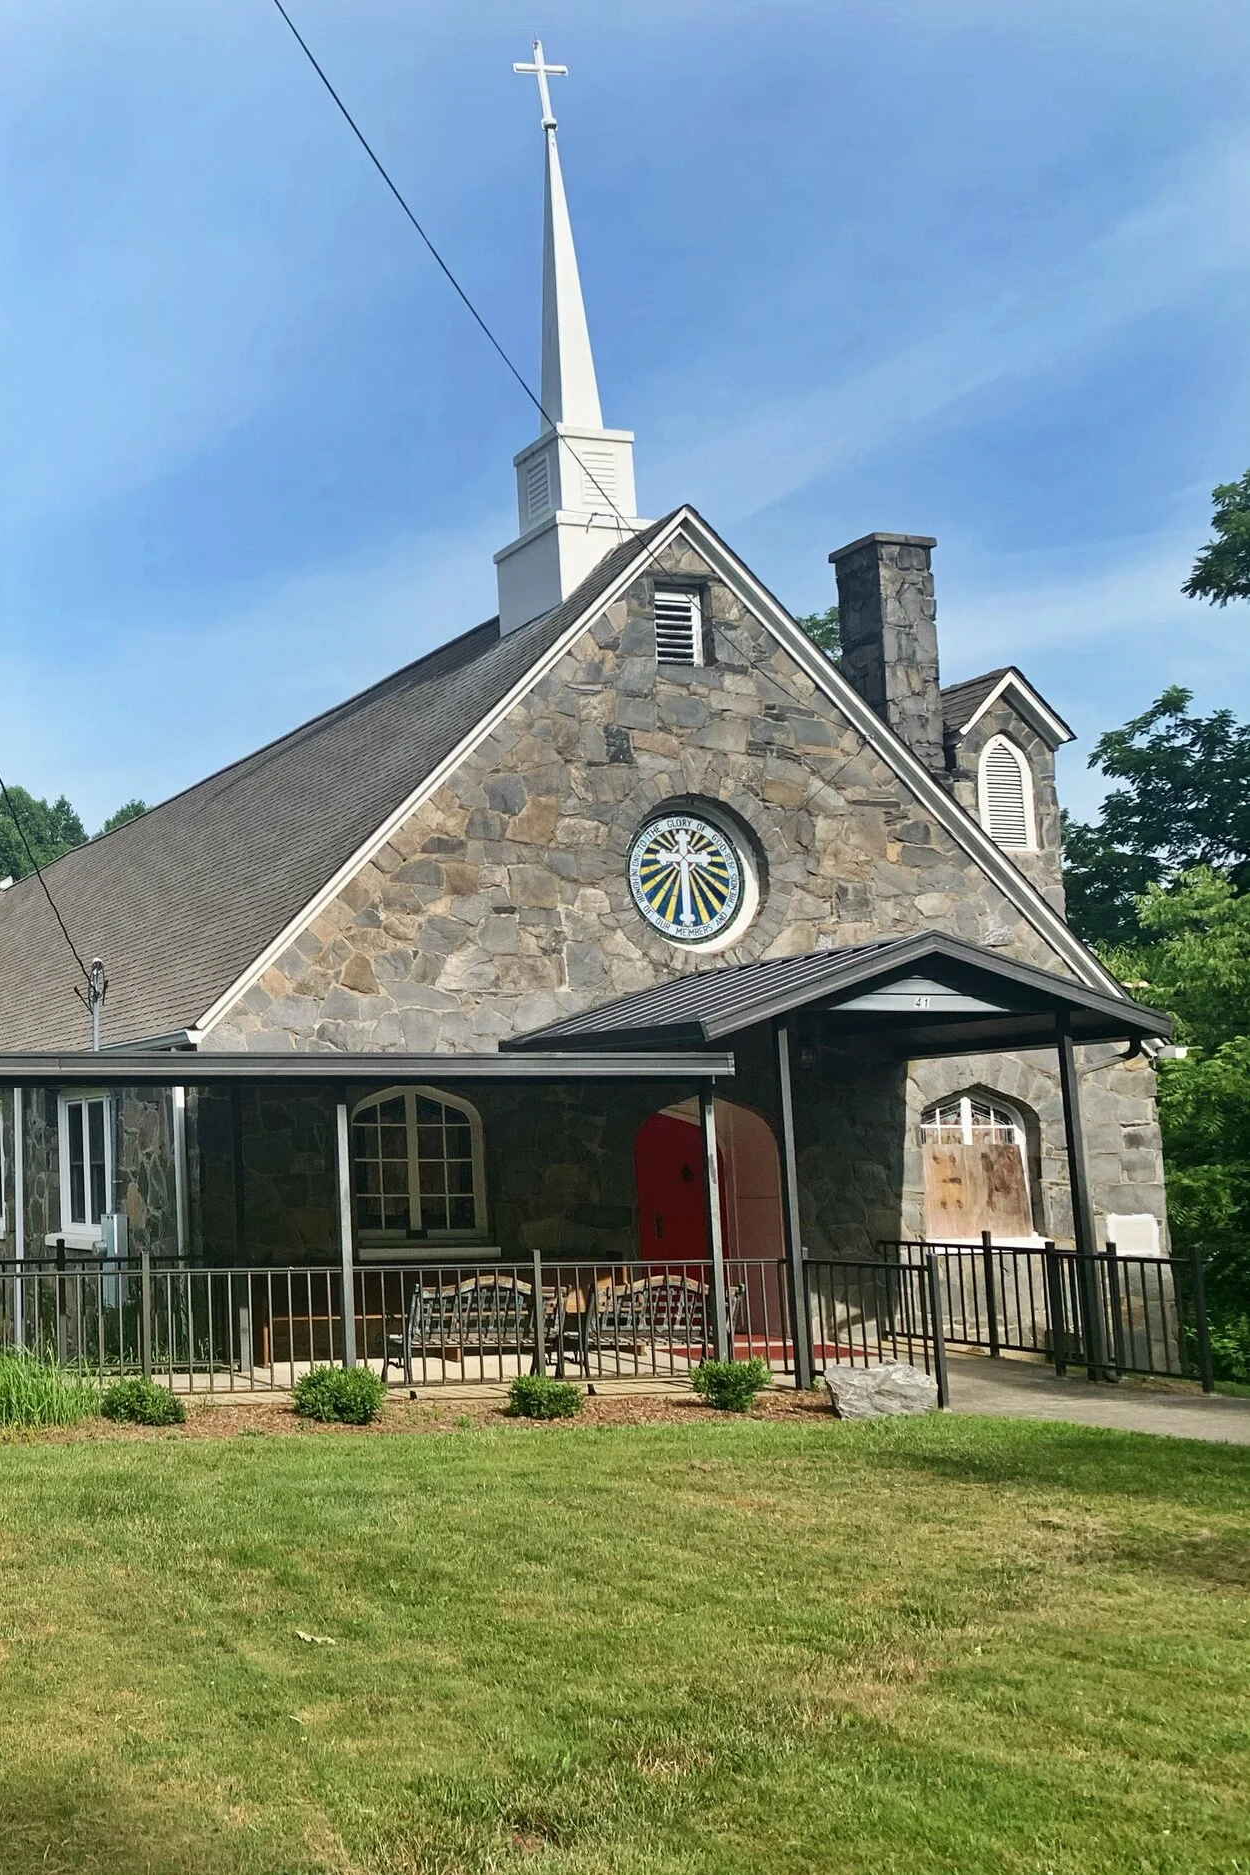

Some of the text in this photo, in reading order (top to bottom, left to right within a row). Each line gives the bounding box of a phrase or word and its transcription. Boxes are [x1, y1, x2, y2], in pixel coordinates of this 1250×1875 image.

[636, 819, 727, 852] TO THE GLORY OF GOD
[631, 878, 646, 904] HONOR
[643, 904, 654, 915] OF
[655, 917, 671, 931] OUR
[675, 924, 714, 937] MEMBERS
[715, 911, 728, 927] AND
[726, 873, 738, 909] FRIENDS
[915, 997, 930, 1008] 41
